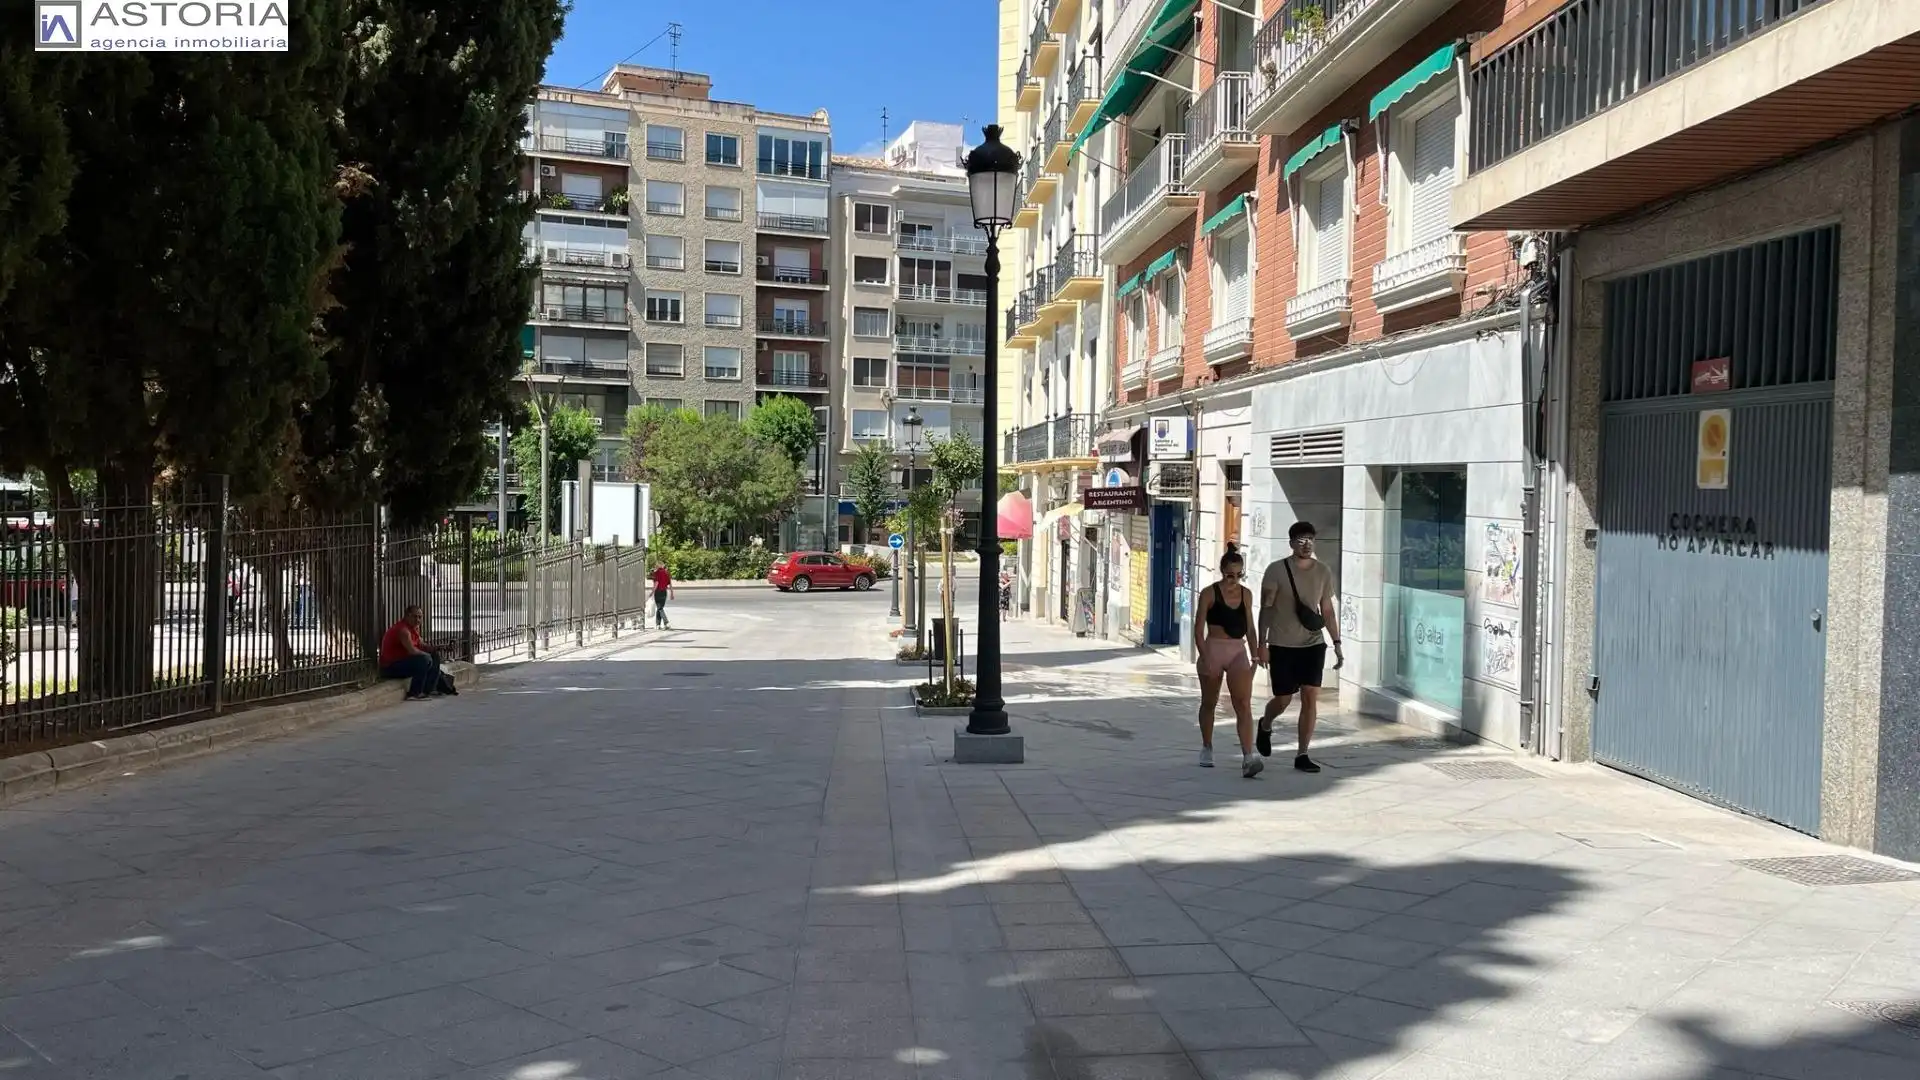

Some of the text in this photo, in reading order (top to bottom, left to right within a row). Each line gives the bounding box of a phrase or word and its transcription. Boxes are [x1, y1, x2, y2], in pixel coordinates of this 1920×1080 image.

[1088, 489, 1137, 498] RESTAURANTE
[1669, 512, 1757, 535] COCHERA
[1657, 533, 1775, 561] NO APARCAR
